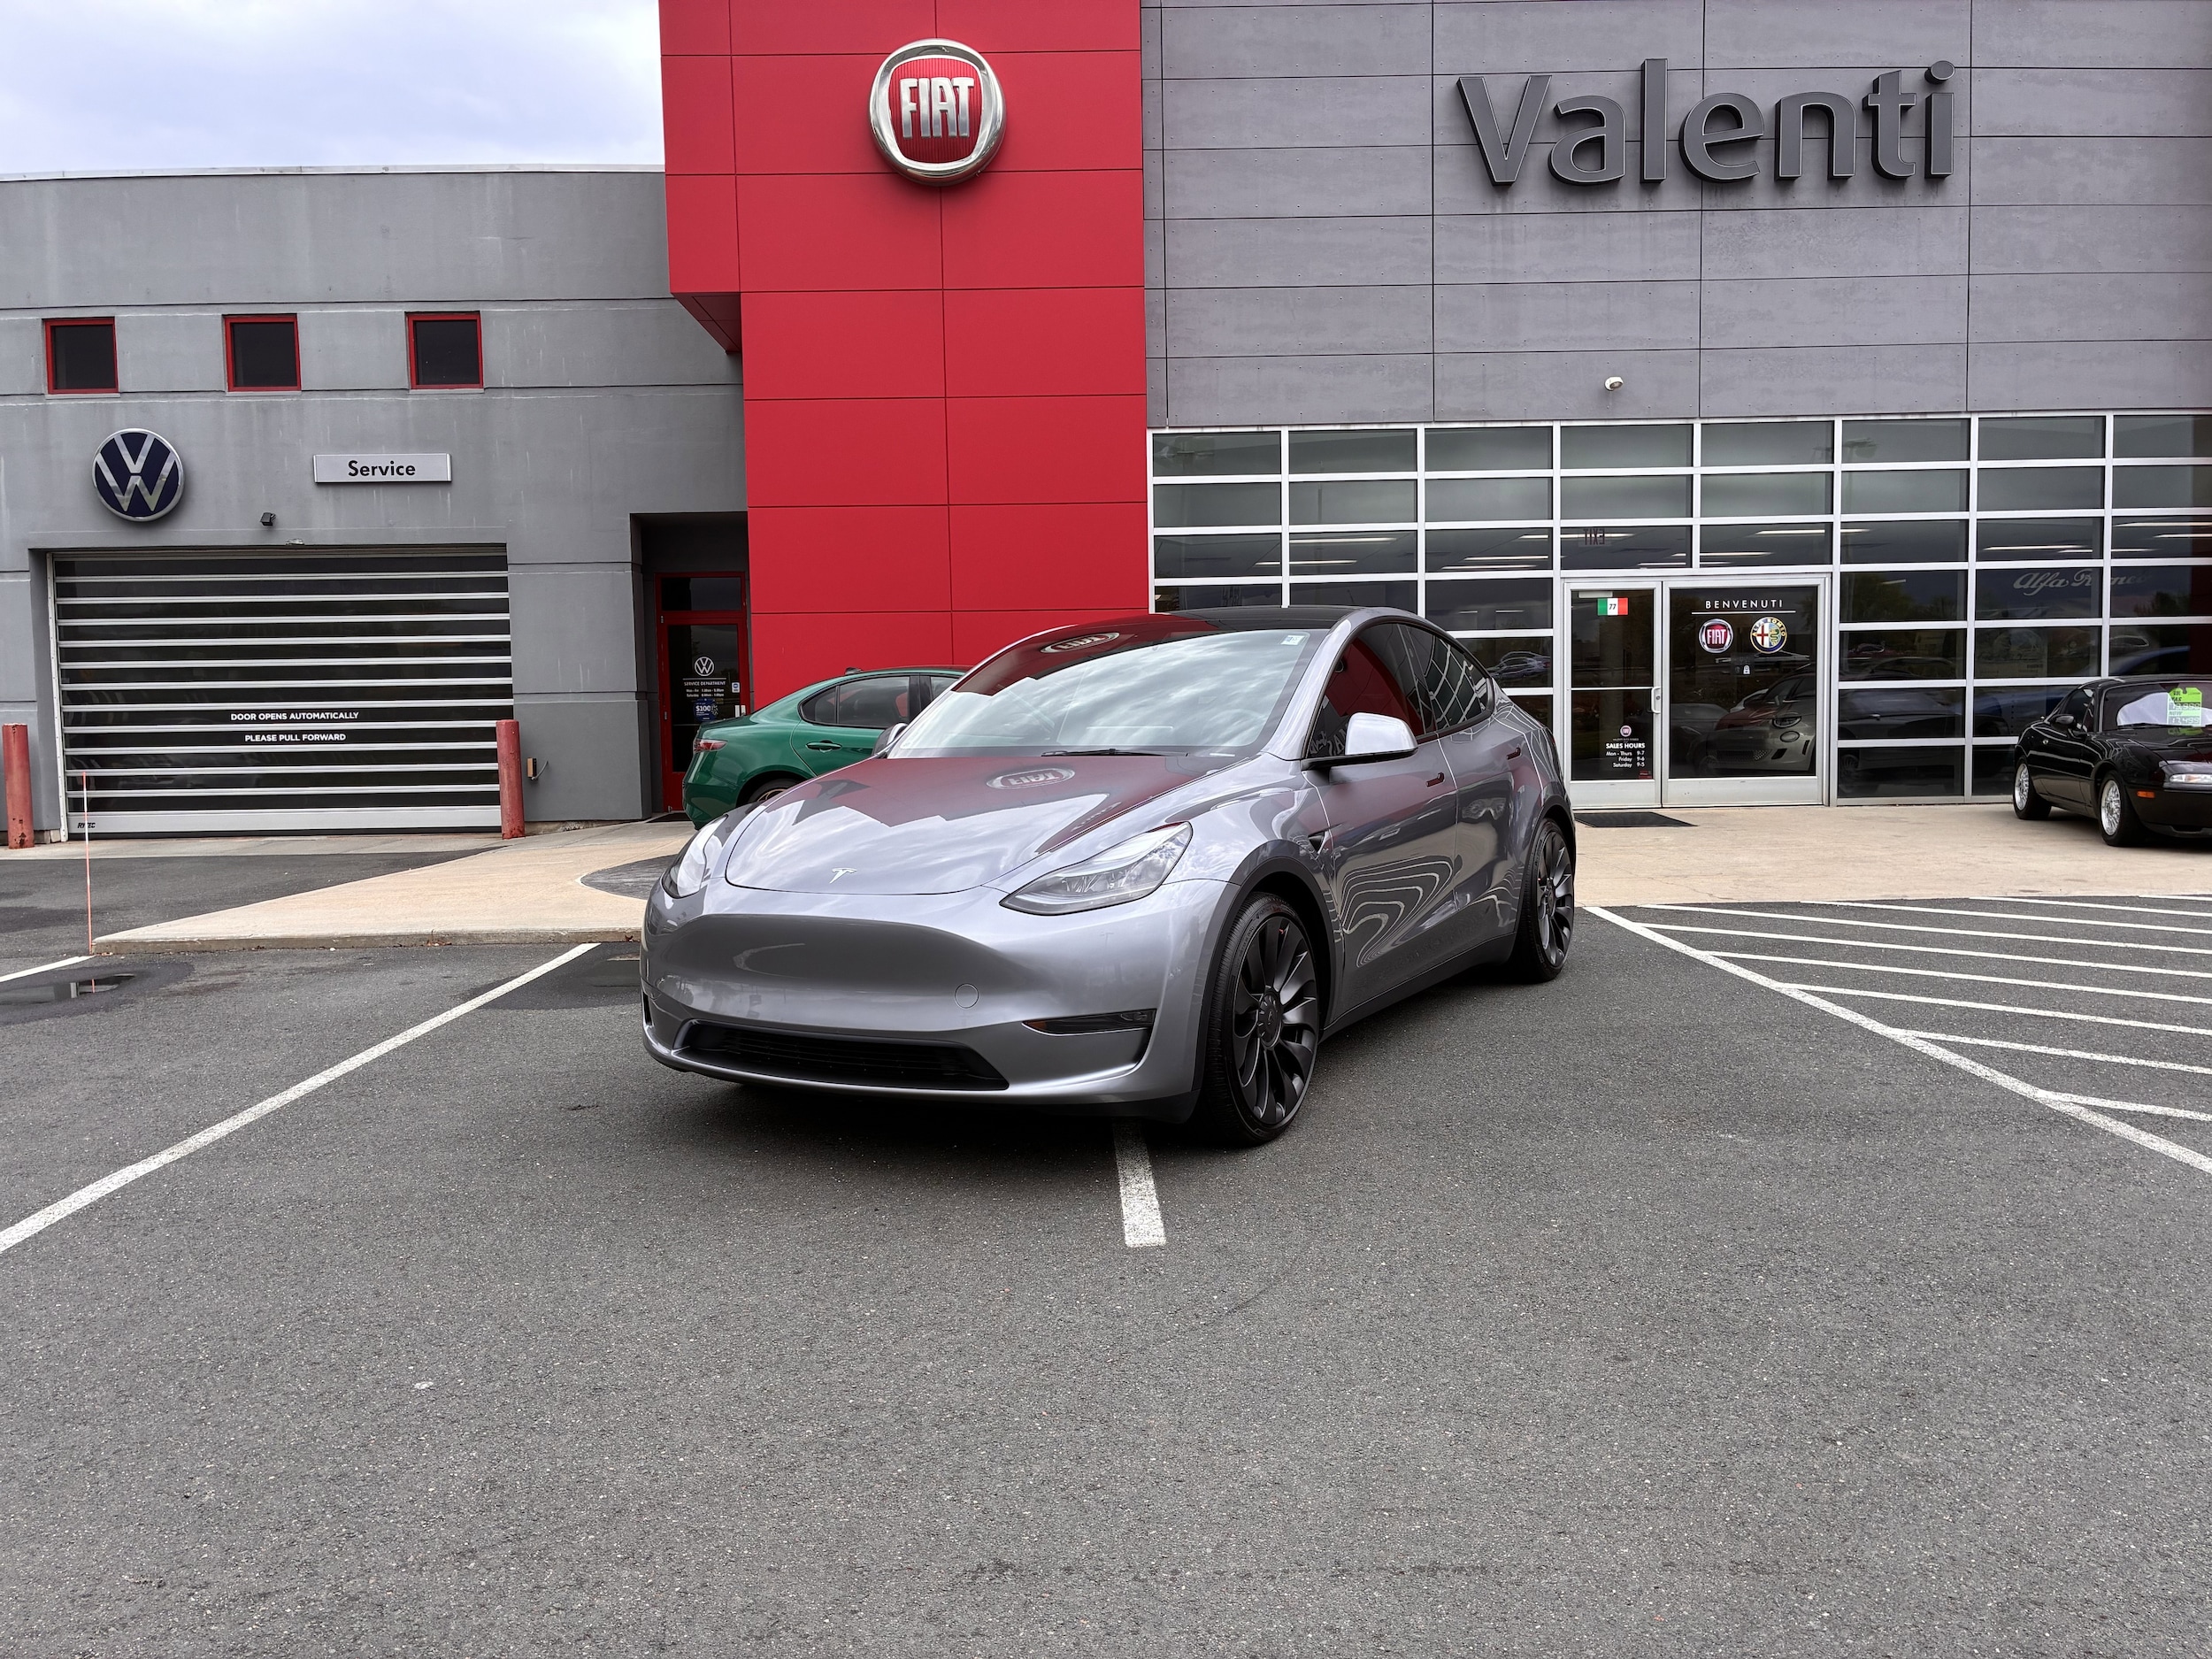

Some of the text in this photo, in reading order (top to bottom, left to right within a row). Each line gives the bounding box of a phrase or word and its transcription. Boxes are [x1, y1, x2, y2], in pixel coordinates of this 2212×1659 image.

[900, 77, 974, 138] FIAT
[1457, 58, 1955, 185] Valenti
[348, 460, 416, 477] Service
[2013, 572, 2069, 595] Alfa
[1705, 600, 1783, 609] BENVENUTI
[1707, 629, 1726, 645] FIAT
[289, 711, 359, 720] AUTOMATICALLY
